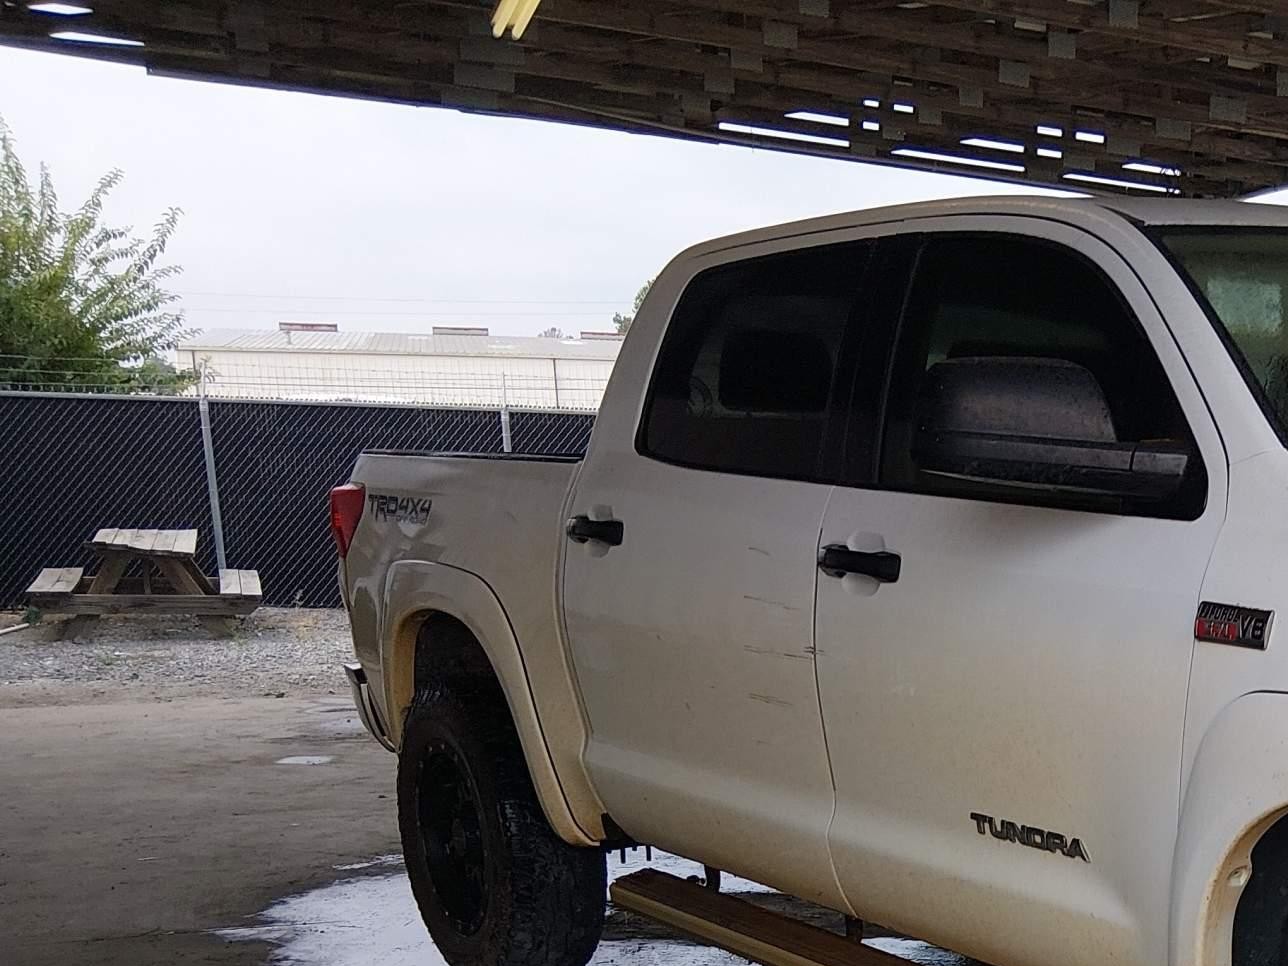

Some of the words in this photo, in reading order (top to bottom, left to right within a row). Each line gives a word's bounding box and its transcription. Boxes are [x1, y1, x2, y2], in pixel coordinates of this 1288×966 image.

[368, 494, 399, 522] TRD
[1239, 614, 1266, 641] V8
[969, 812, 1091, 863] TUNDRA
